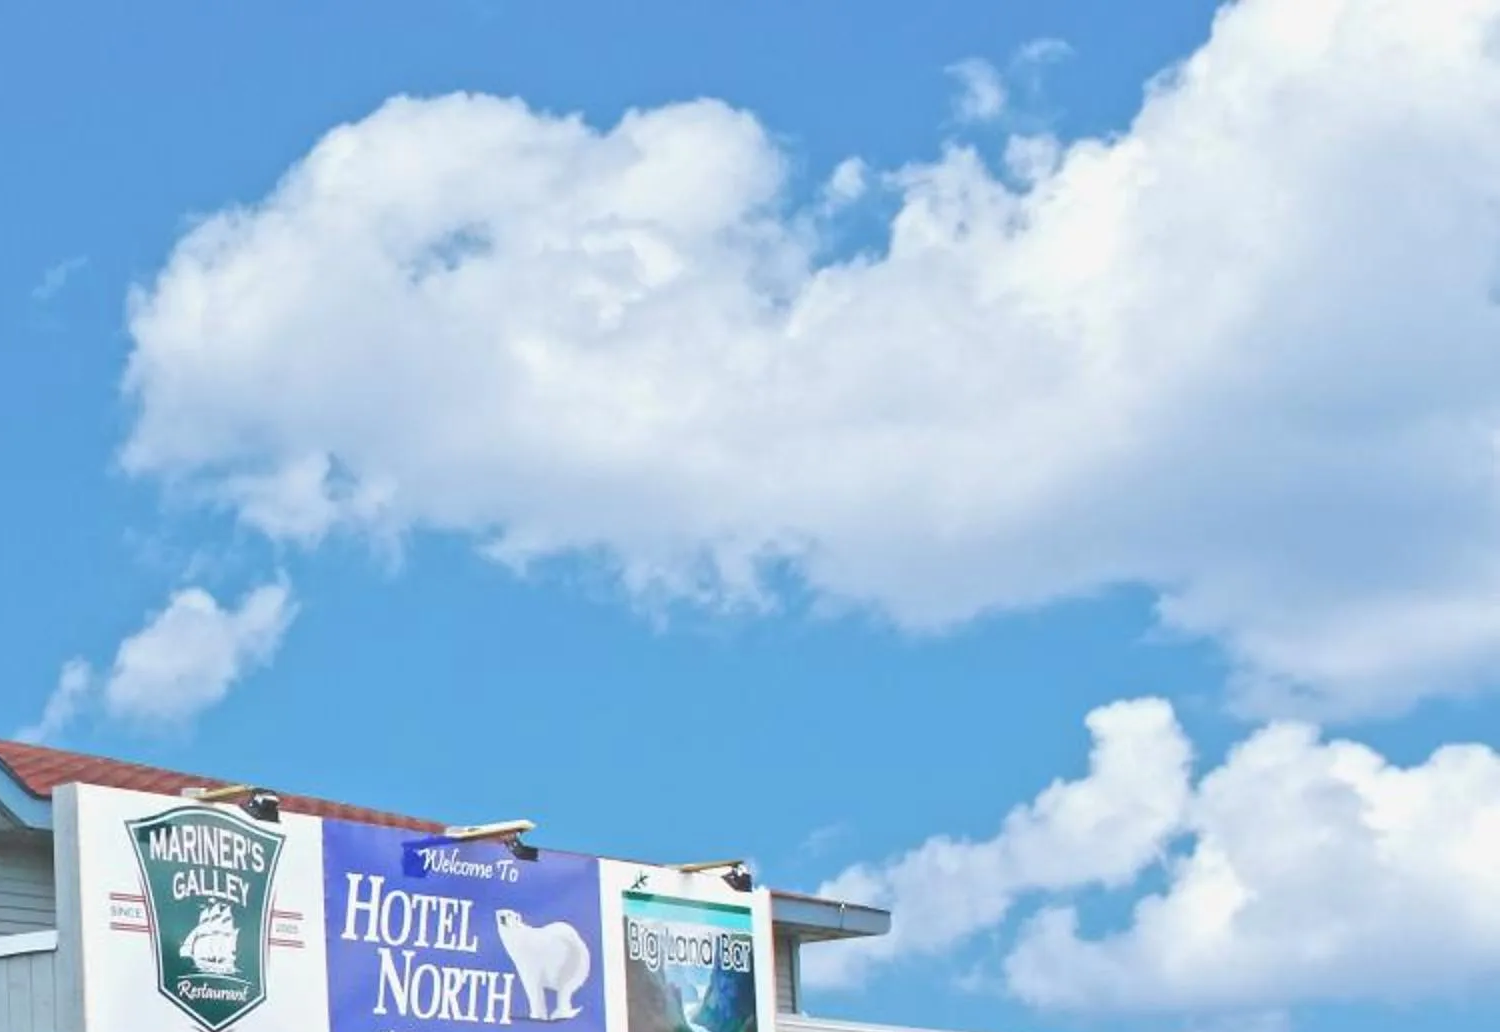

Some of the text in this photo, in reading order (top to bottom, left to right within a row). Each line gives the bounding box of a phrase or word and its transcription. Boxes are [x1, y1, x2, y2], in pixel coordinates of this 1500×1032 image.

[149, 823, 266, 873] MARINER'S
[418, 847, 519, 882] Welcome To
[172, 868, 250, 908] GALLEY
[110, 905, 143, 919] SINCE
[341, 872, 478, 953] HOTEL
[629, 920, 751, 972] Big Land Bar
[177, 979, 249, 1002] Restaurant
[373, 948, 515, 1024] NORTH
